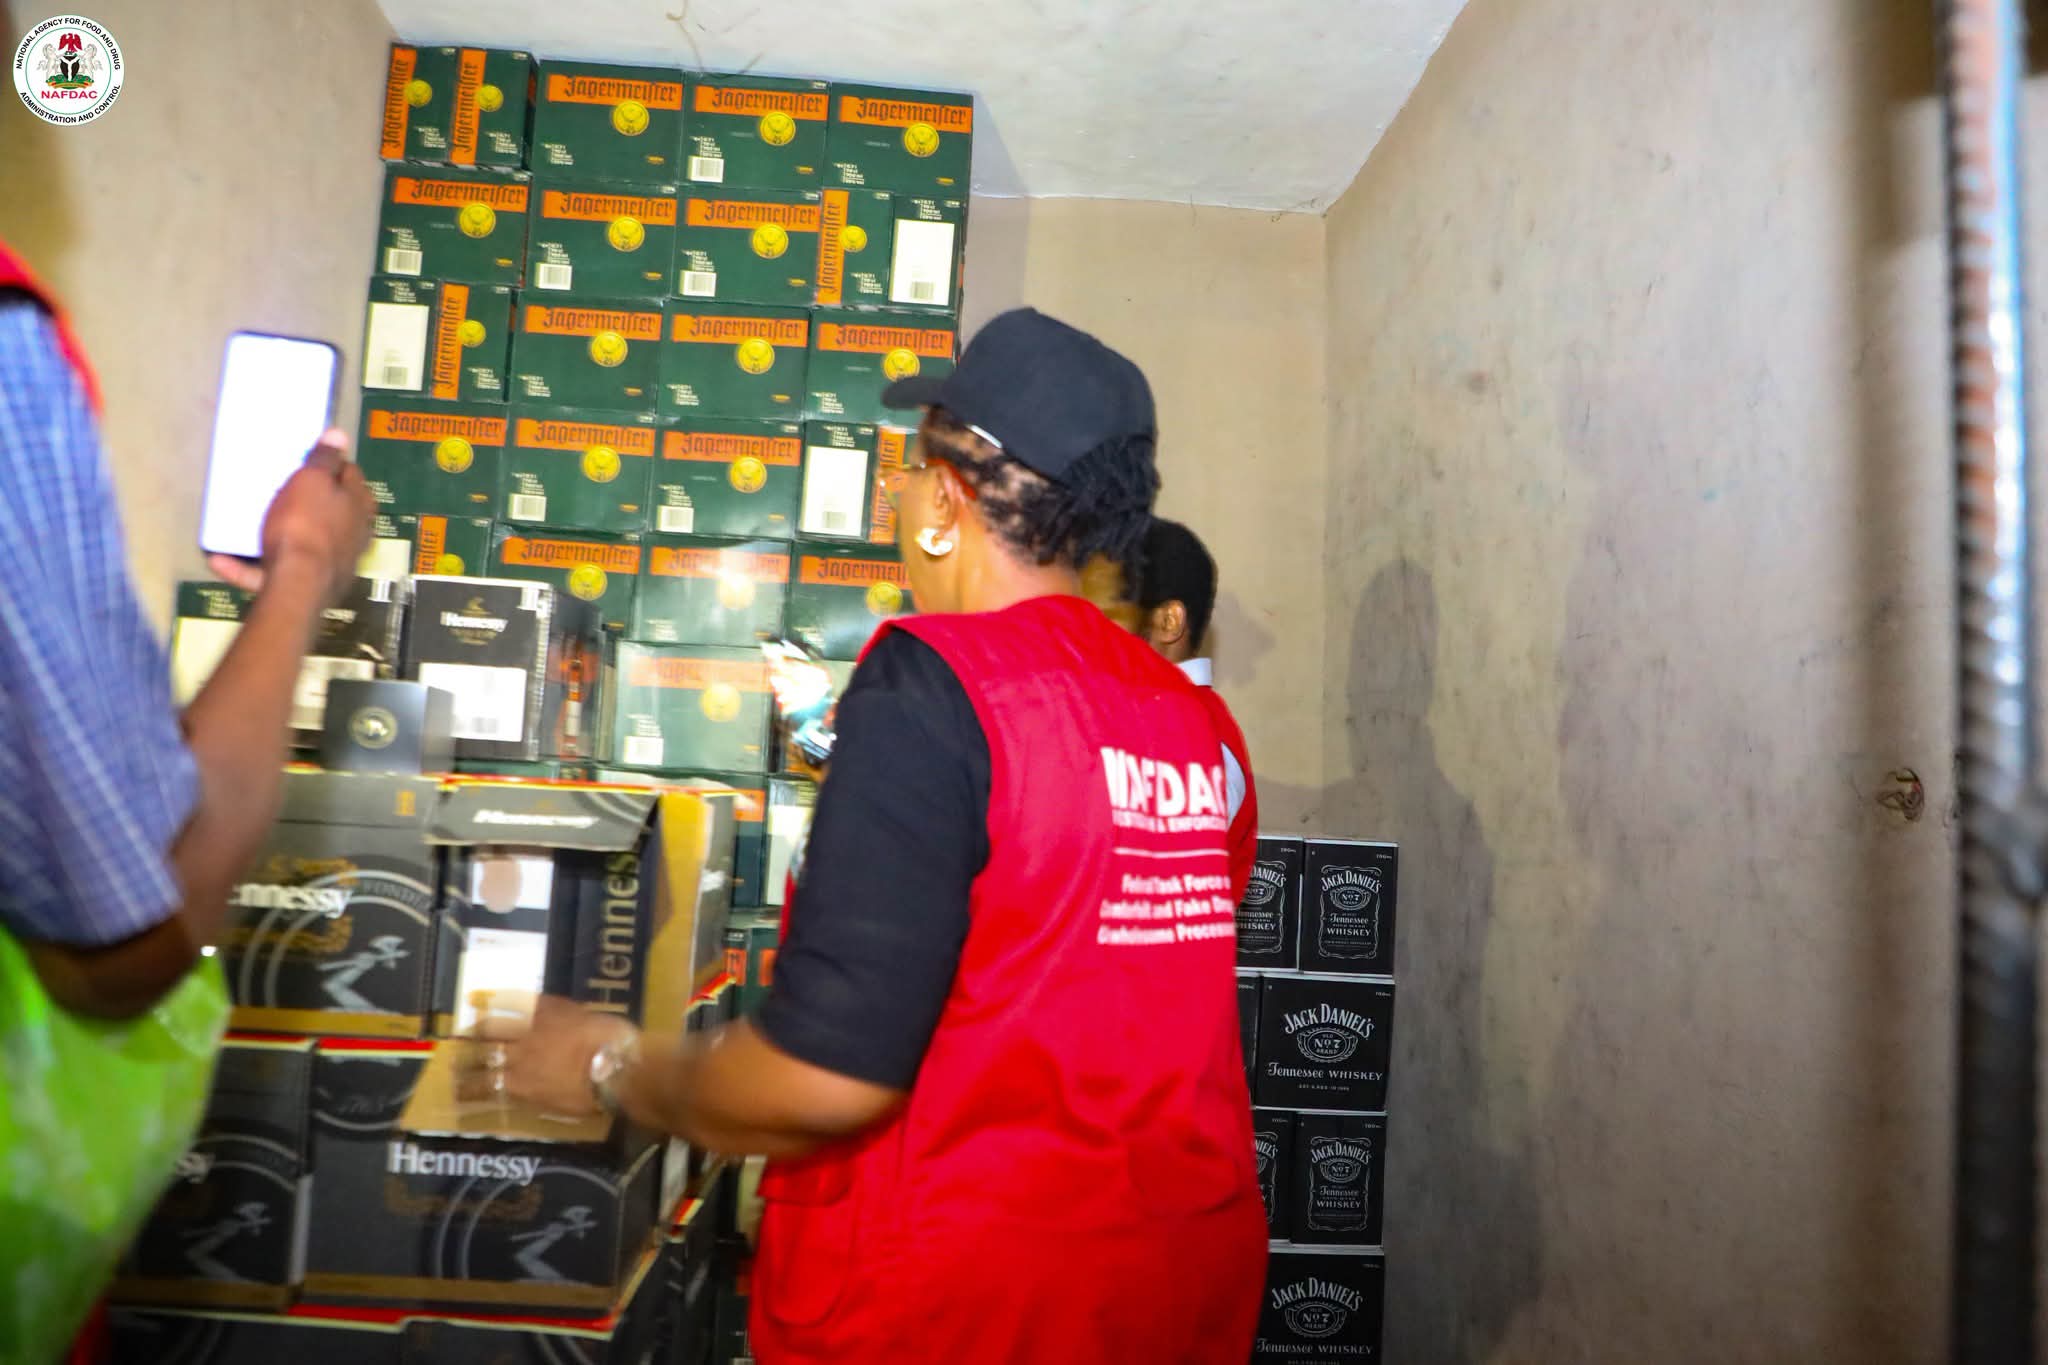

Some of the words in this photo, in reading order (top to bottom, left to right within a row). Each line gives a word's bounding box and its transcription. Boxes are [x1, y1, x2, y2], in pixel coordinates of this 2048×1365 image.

[1321, 873, 1345, 891] JACK
[1345, 870, 1382, 894] DANIEL'S
[1330, 912, 1369, 924] Tennessee
[587, 852, 640, 1015] Hennes
[1327, 927, 1371, 936] WHISKEY
[1284, 1008, 1319, 1034] JACK
[1321, 1003, 1375, 1040] DANIEL'S
[1267, 1062, 1324, 1079] Tennessee
[1328, 1070, 1383, 1081] WHISKEY
[1254, 1139, 1278, 1158] NIEL'S
[1311, 1147, 1335, 1164] JACK
[1335, 1141, 1372, 1165] DANIEL'S
[388, 1141, 540, 1186] Hennessy
[1320, 1185, 1359, 1197] Tennessee
[1316, 1199, 1361, 1209] WHISKEY
[1272, 1281, 1306, 1310] JACK
[1308, 1276, 1363, 1312] DANIEL'S
[1256, 1337, 1313, 1354] Tennessee
[1317, 1343, 1374, 1355] WHISKEY
